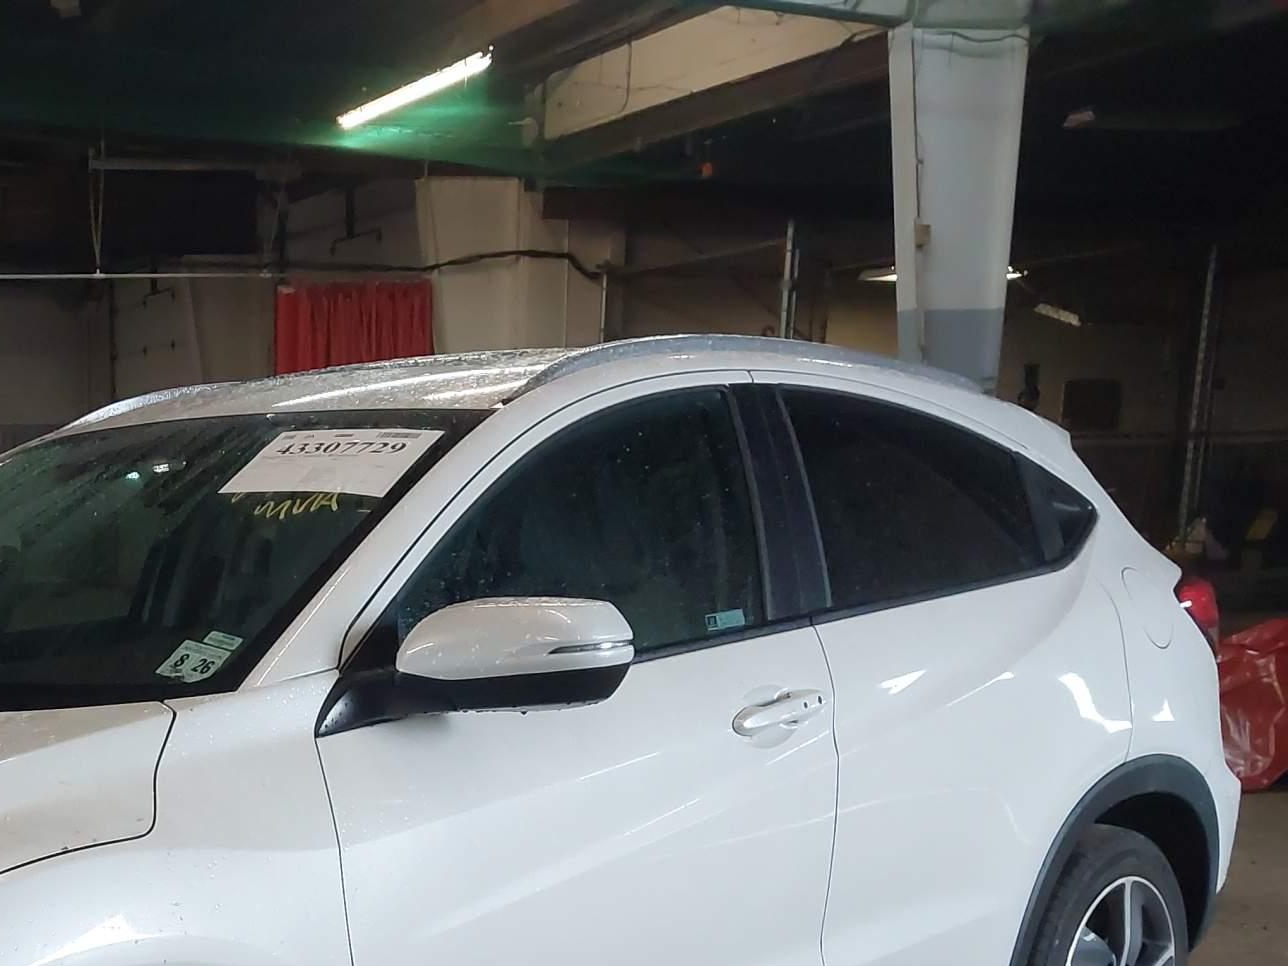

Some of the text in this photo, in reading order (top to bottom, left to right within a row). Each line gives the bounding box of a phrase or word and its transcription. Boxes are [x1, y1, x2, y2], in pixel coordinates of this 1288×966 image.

[275, 440, 409, 456] 43307729
[173, 653, 215, 675] 8 26
